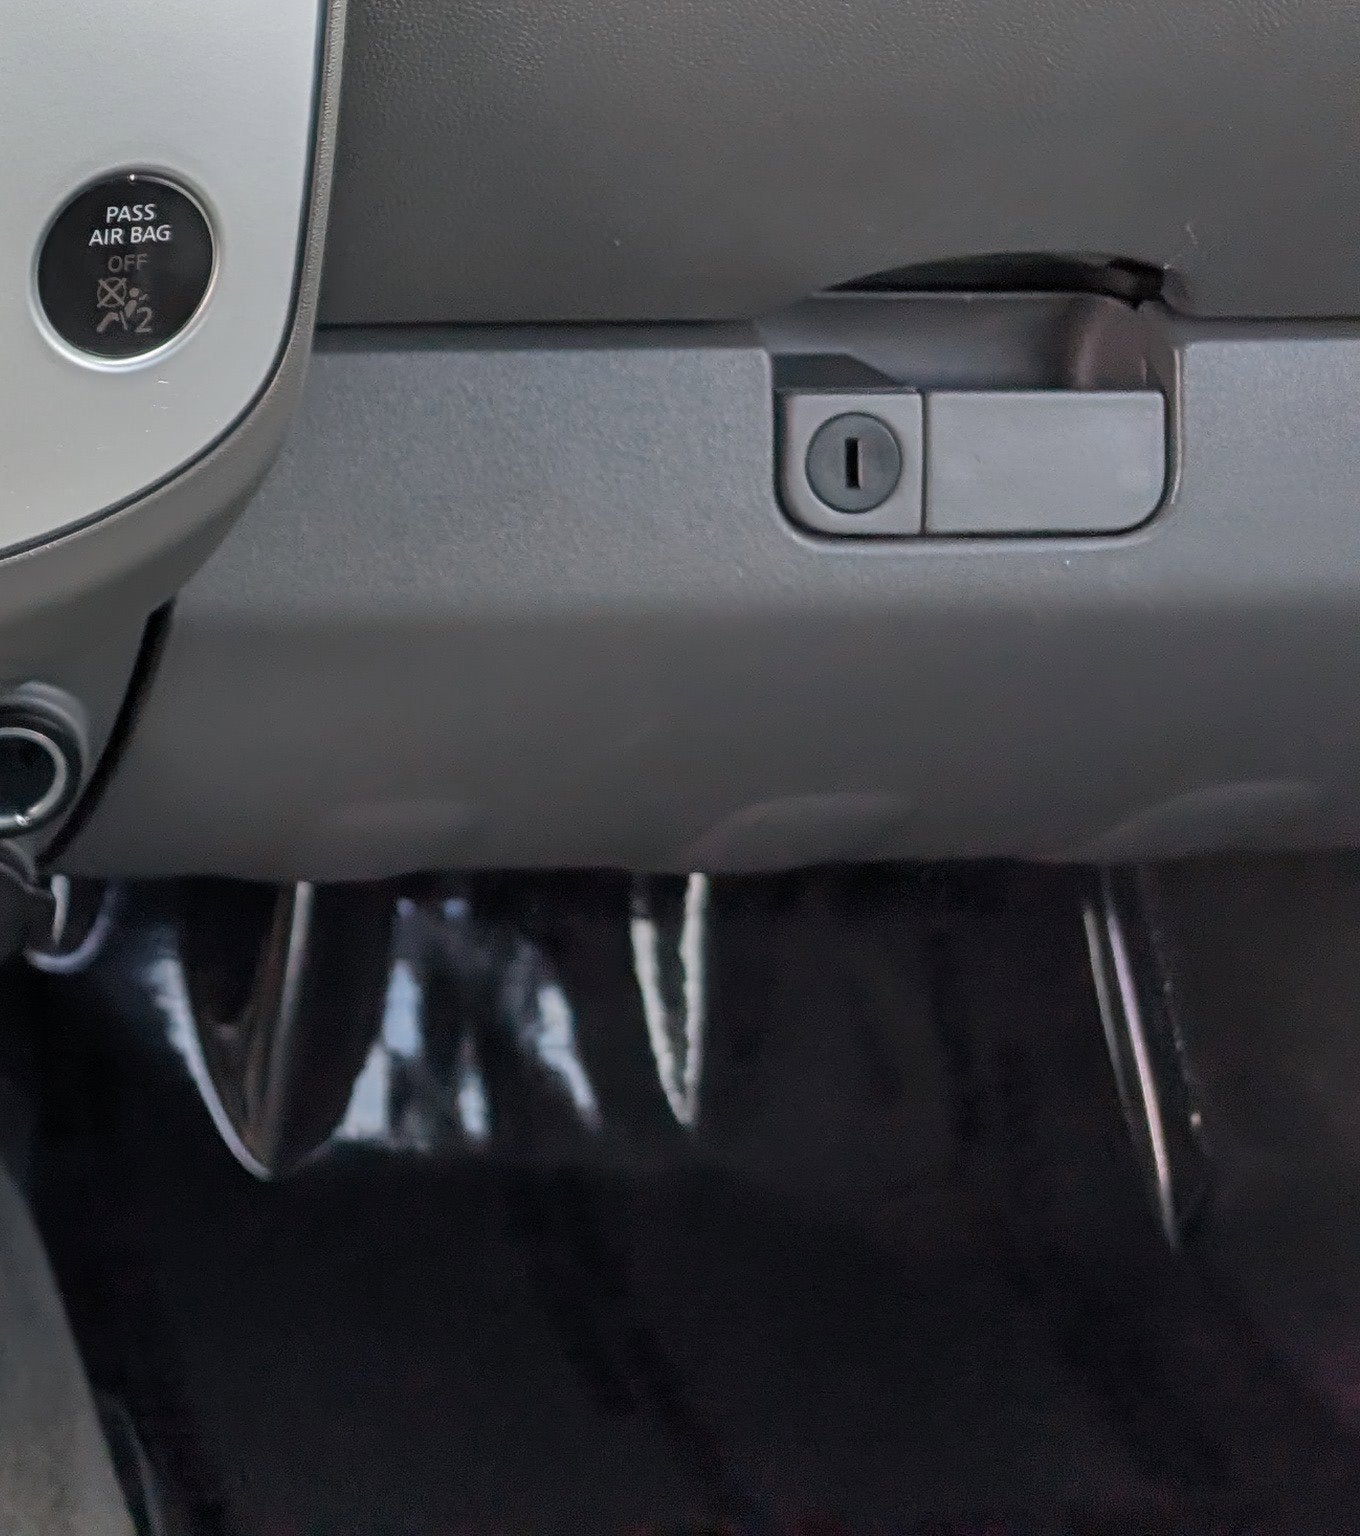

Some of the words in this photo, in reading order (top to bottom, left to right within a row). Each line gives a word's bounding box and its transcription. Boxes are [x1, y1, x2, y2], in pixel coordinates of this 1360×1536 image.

[106, 203, 157, 224] PASS
[87, 228, 126, 247] AIR
[130, 224, 173, 244] BAG
[107, 252, 149, 273] OFF
[134, 306, 155, 334] 2
